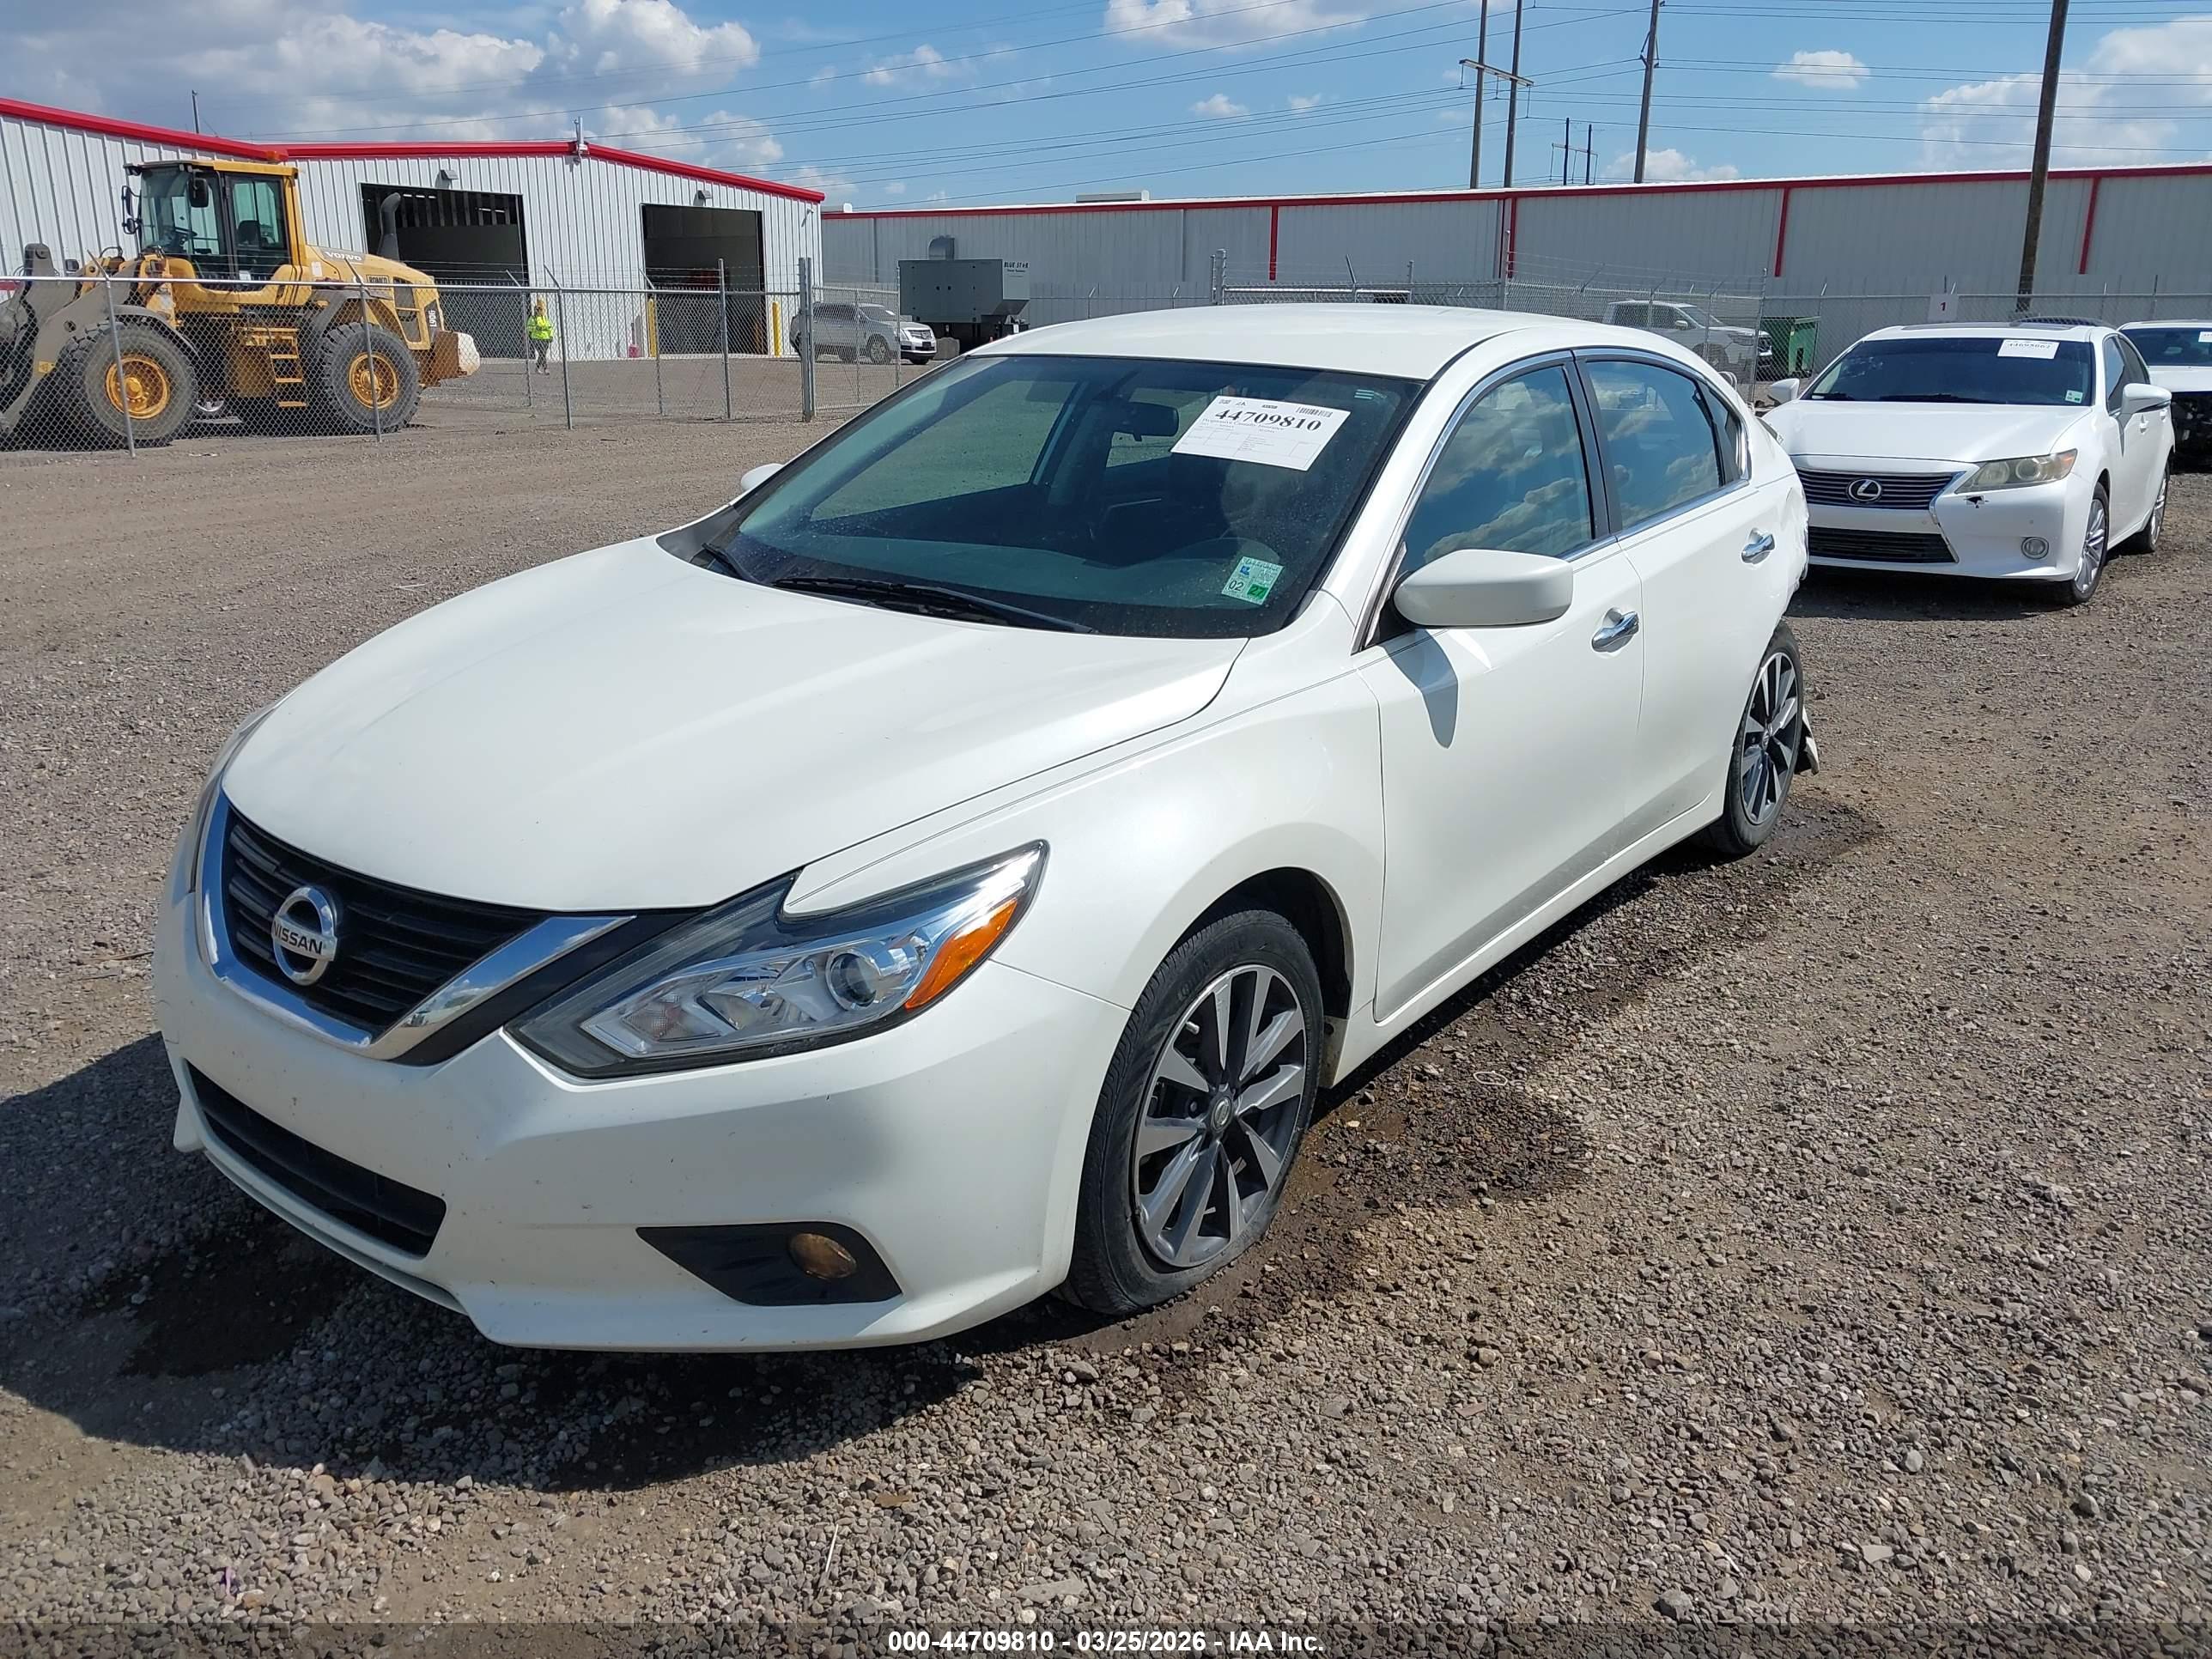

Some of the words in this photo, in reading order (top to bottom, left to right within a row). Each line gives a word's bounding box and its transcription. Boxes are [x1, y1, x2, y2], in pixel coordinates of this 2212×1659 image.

[1940, 301, 1947, 312] 1
[1215, 409, 1322, 431] 44709810
[1228, 580, 1244, 592] 02
[1249, 586, 1265, 597] 27
[274, 921, 323, 955] NISSAN
